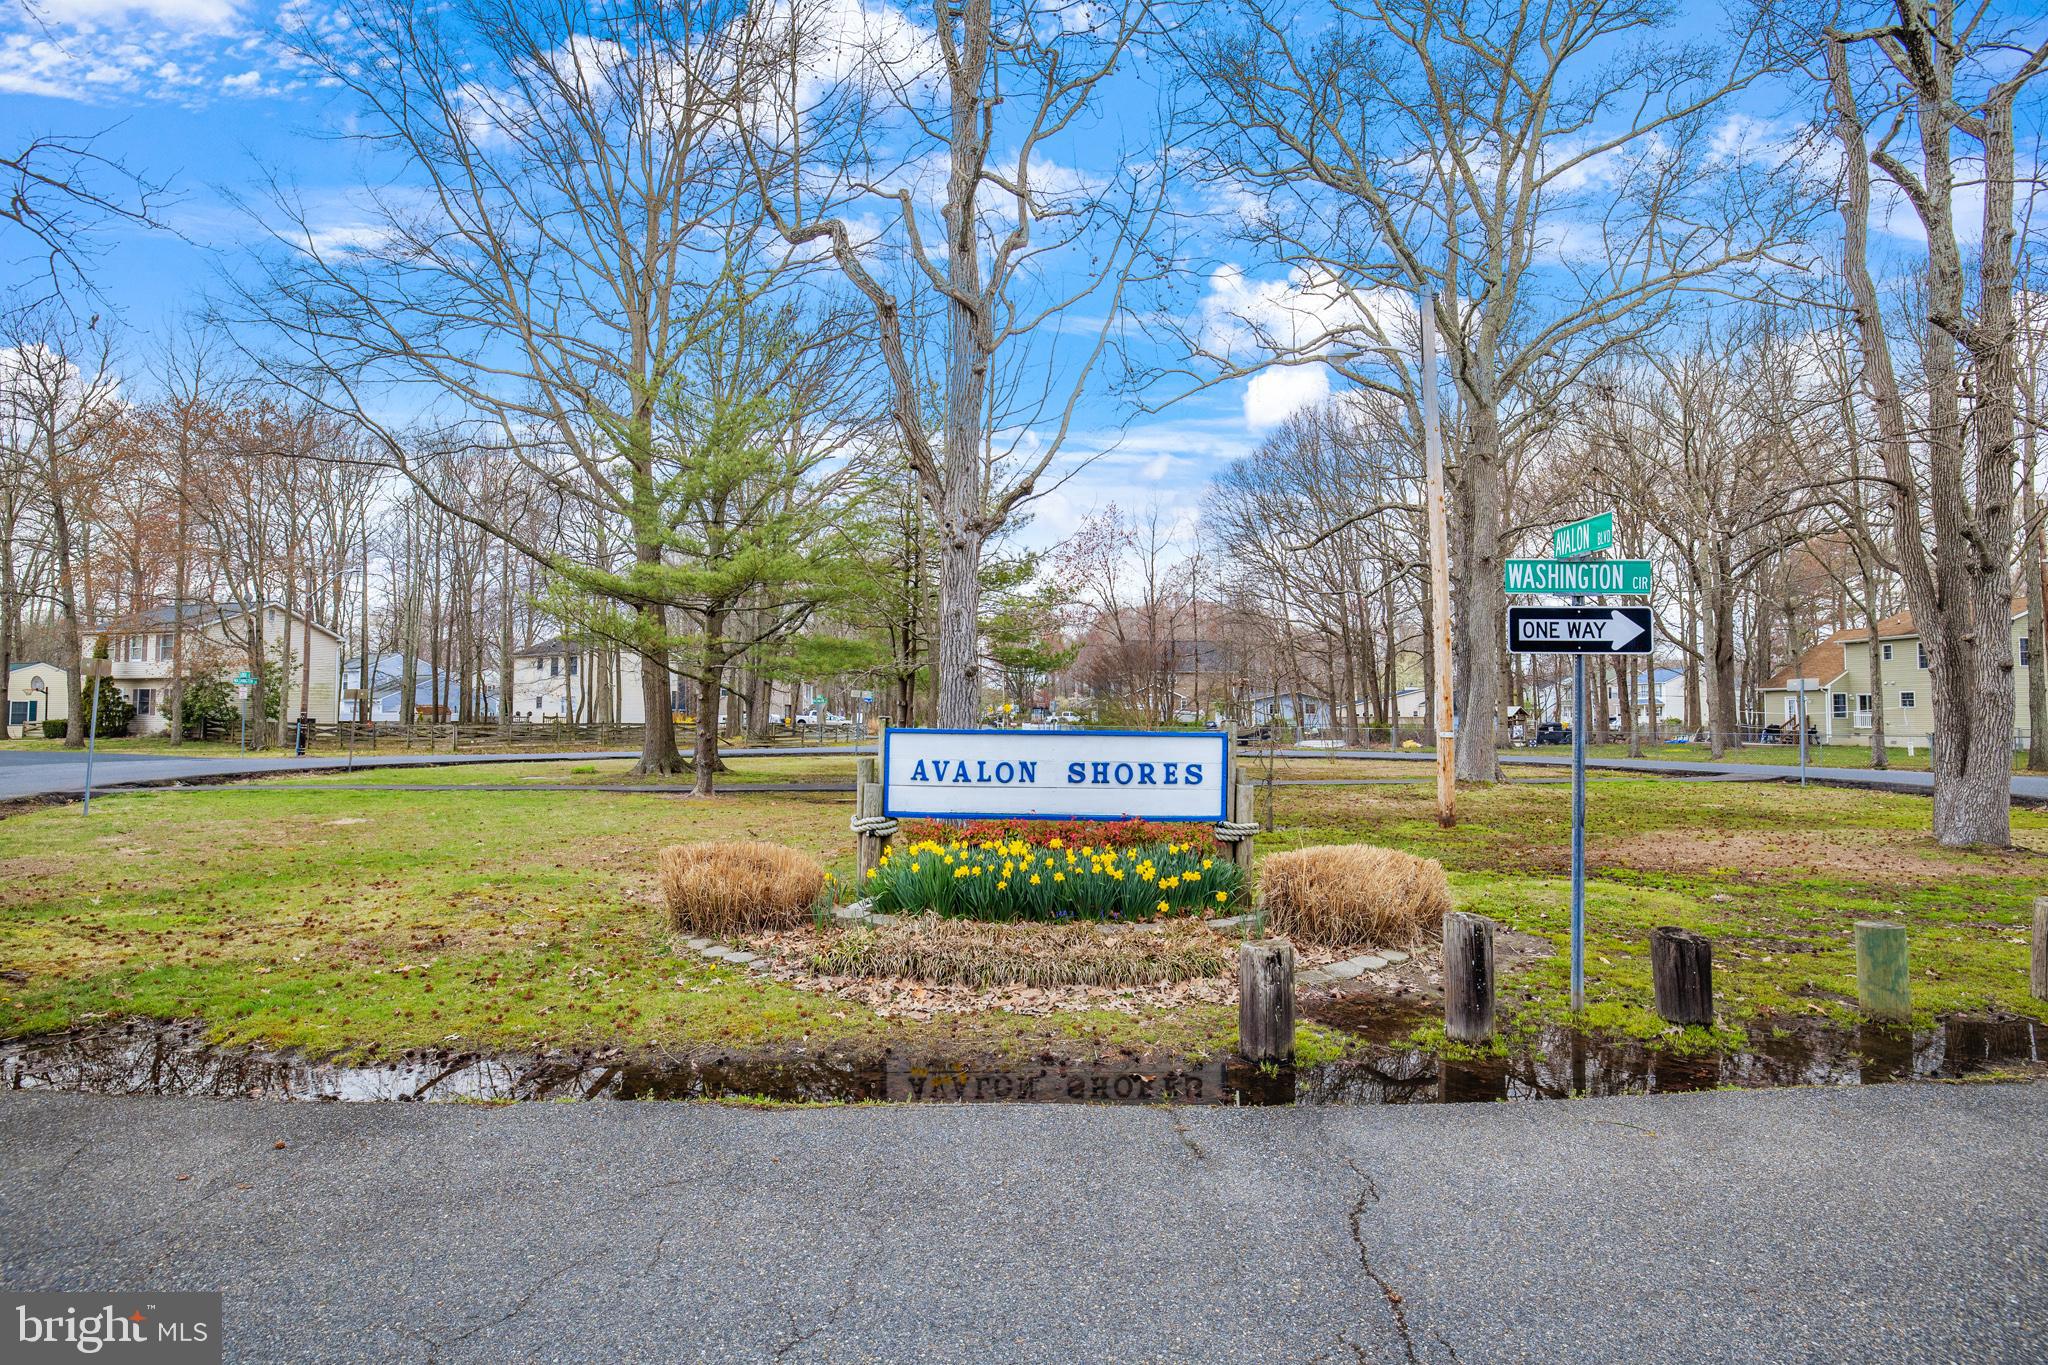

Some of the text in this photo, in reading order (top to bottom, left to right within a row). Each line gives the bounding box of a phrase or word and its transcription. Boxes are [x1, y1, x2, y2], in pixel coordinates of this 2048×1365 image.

[1555, 523, 1611, 557] AVALON BLVD
[1508, 563, 1649, 590] WASHINGTON CIR
[1523, 621, 1607, 639] ONE WAY
[910, 758, 1204, 785] AVALON SHORES
